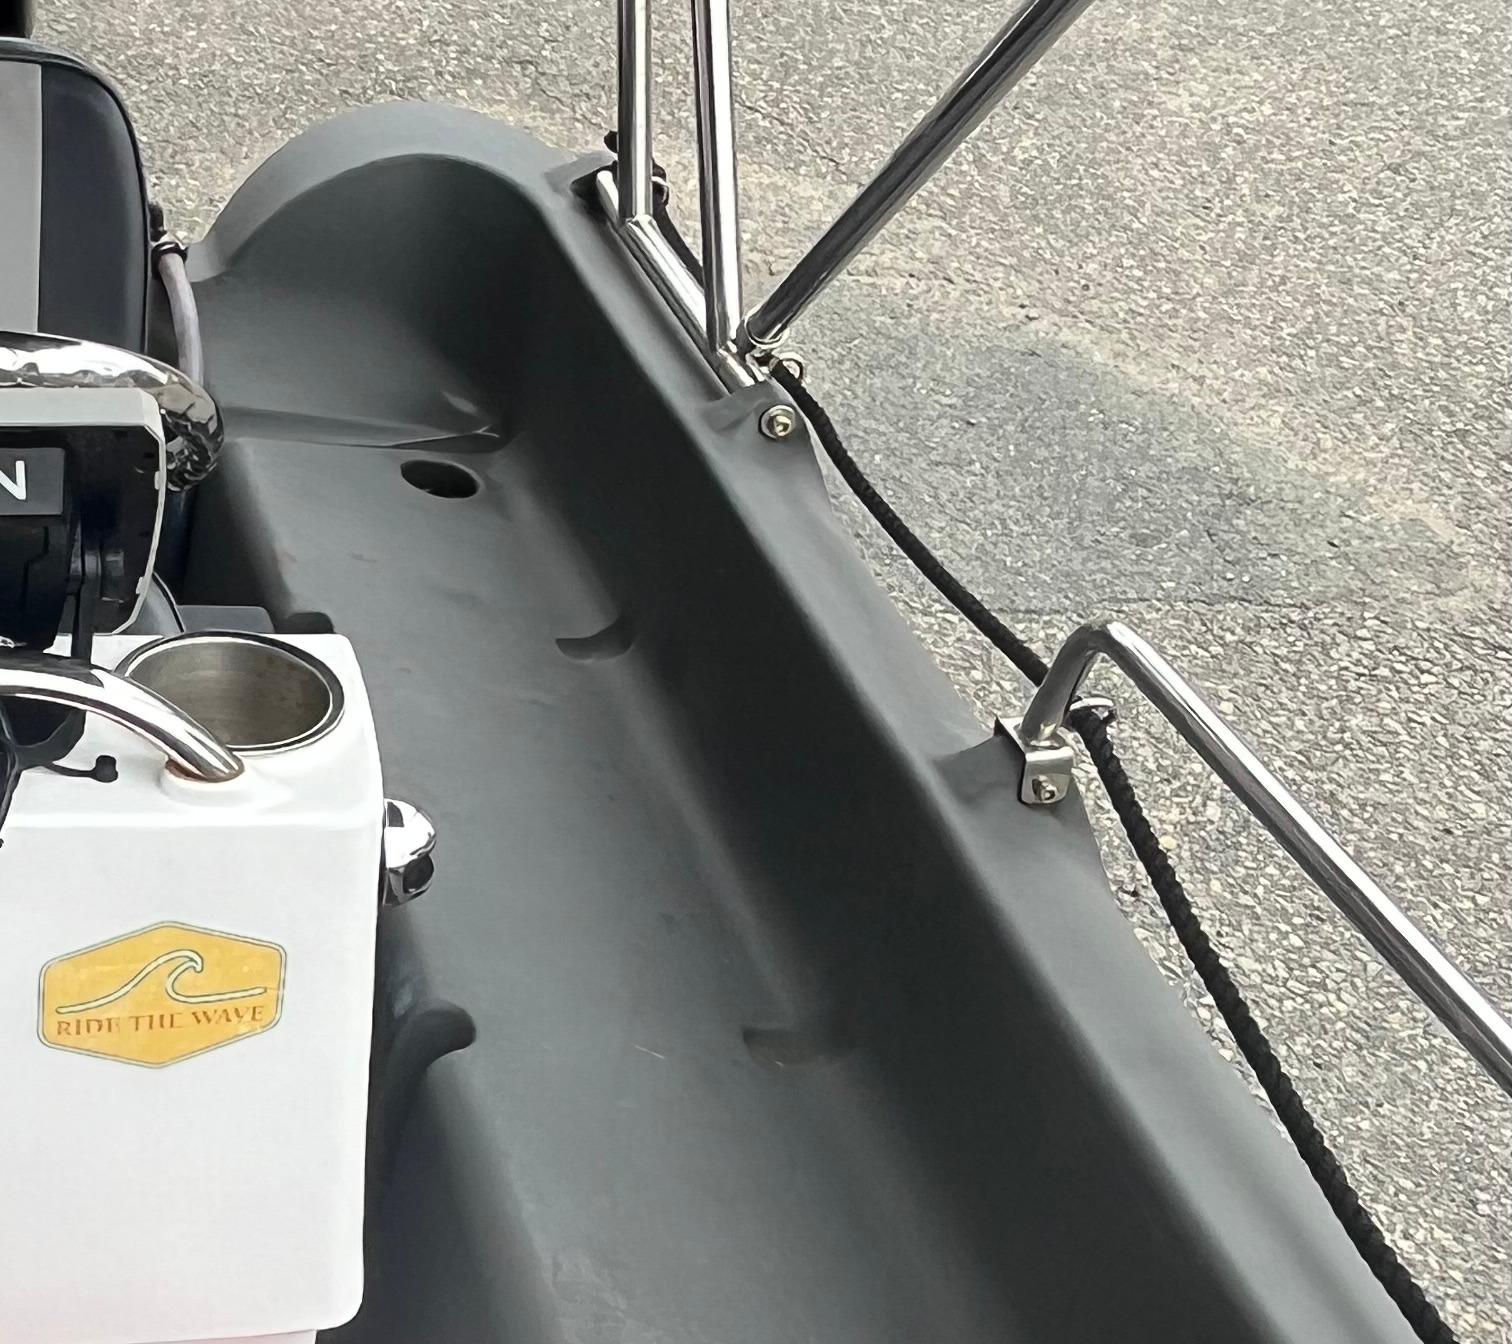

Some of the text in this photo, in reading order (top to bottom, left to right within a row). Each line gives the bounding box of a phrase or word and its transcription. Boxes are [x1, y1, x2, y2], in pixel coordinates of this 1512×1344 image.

[56, 1005, 265, 1037] RIDE THE WAVE
